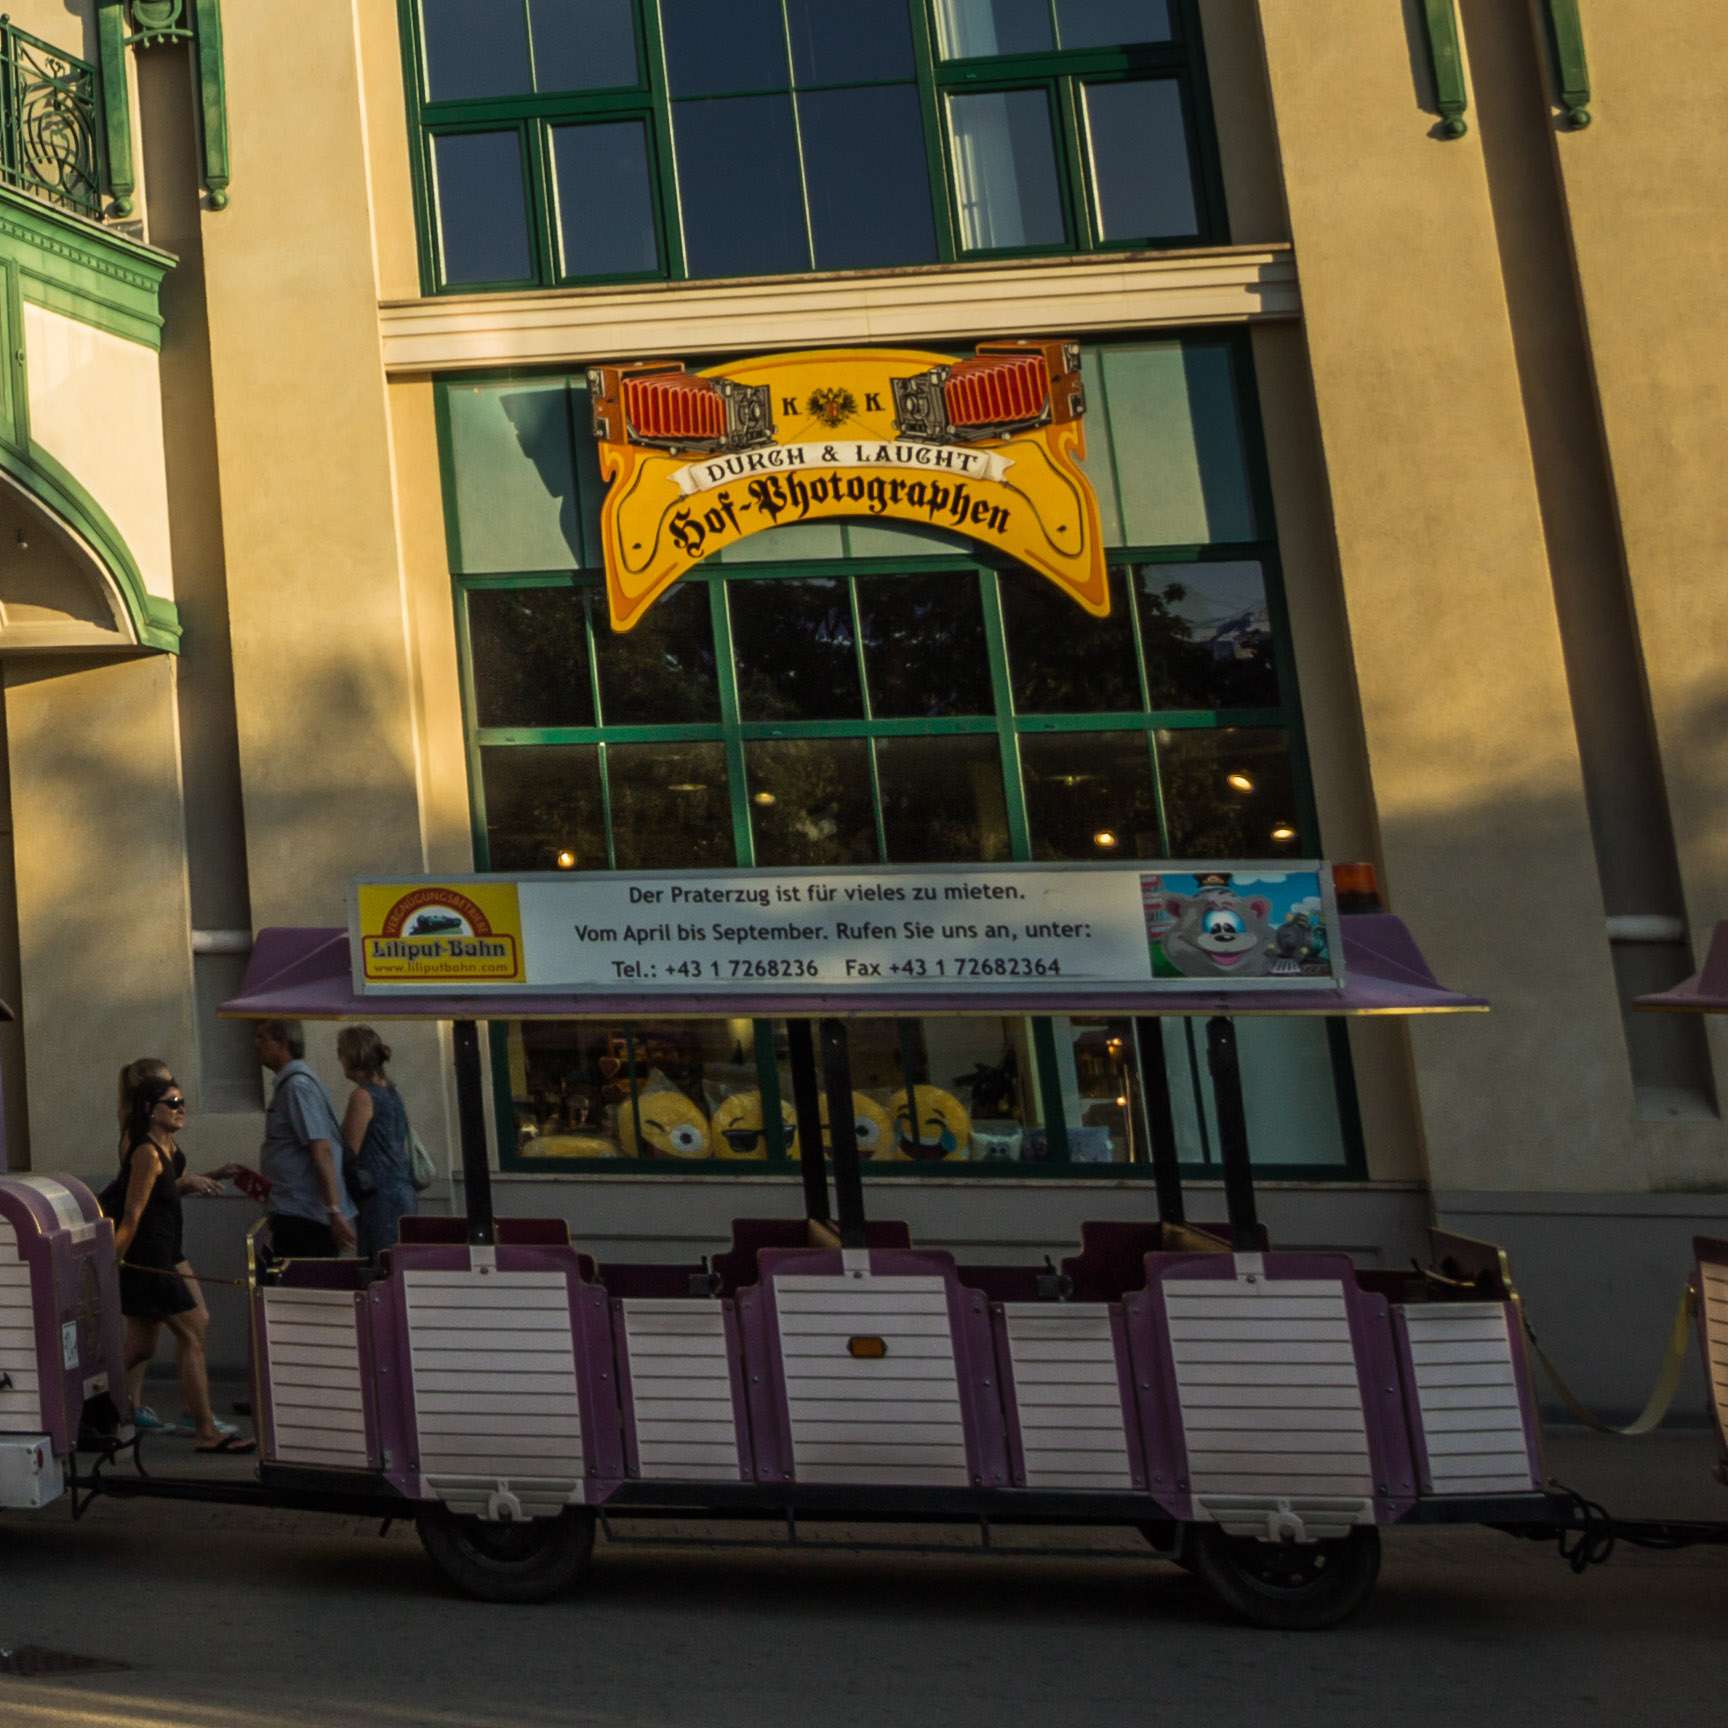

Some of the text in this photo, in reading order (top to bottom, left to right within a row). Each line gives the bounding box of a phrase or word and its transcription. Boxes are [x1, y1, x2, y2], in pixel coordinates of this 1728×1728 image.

[707, 445, 978, 483] DURCH & LAUCHT
[668, 471, 1010, 558] Hof-Photographen
[630, 883, 1025, 906] Der Praterzug ist für vieles zu mieten.
[575, 921, 1092, 945] Vom April bis September. Rufen Sie uns an, unter:
[372, 941, 505, 960] Liliput-Bahn
[374, 963, 508, 973] www.liliputbahn.com
[611, 960, 818, 978] Tel.: +43 1 7268236
[845, 958, 1061, 976] Fax +43 1 72682364
